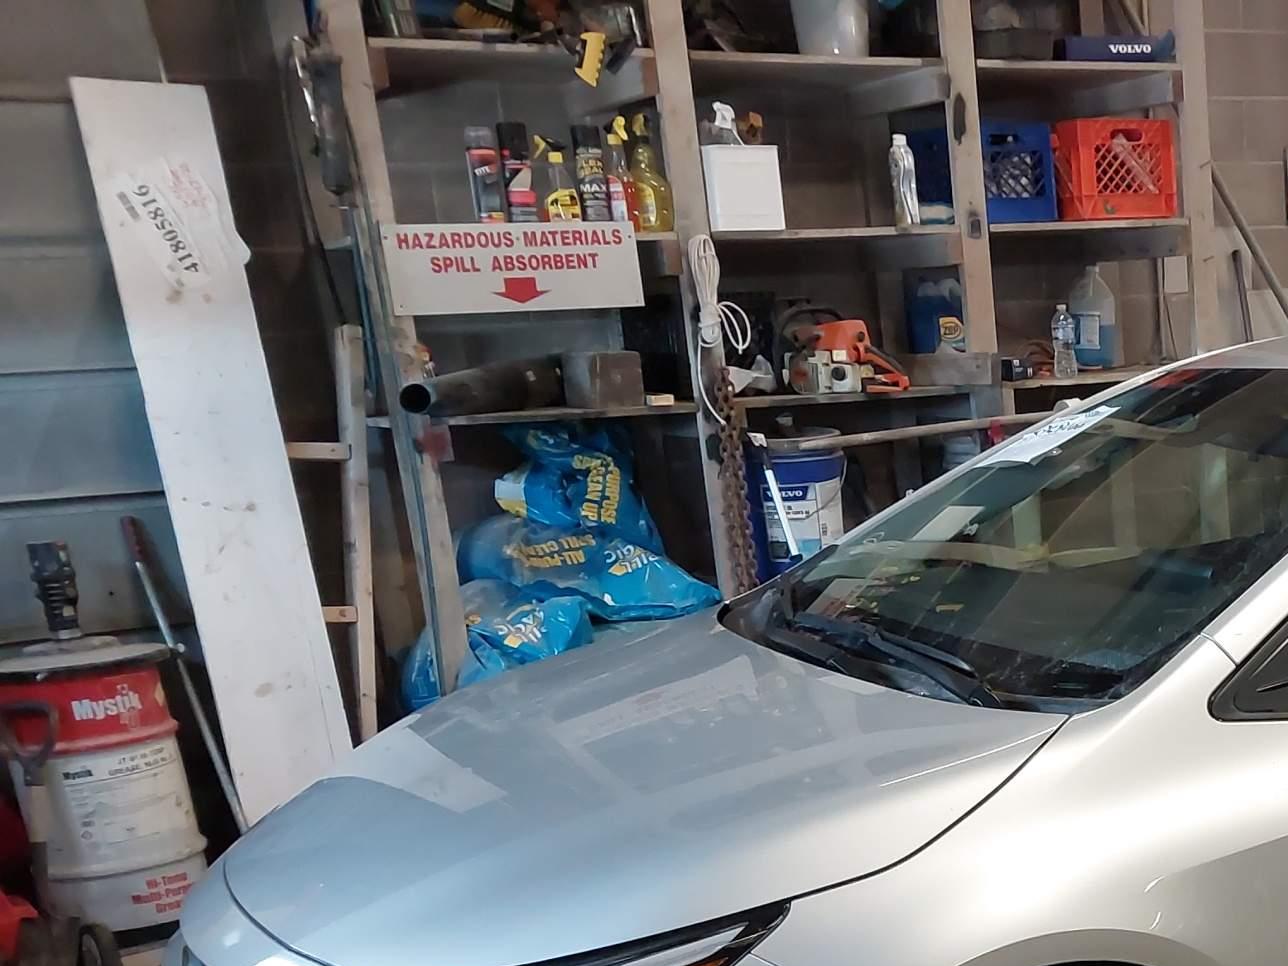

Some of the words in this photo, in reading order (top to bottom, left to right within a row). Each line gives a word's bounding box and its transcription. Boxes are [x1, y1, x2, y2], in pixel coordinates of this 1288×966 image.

[1108, 43, 1152, 54] VOLVO
[580, 183, 607, 193] MAX
[132, 184, 200, 273] 41805816
[396, 231, 515, 250] HAZARDOUS
[523, 228, 623, 247] MATERIALS
[430, 255, 481, 273] SPILL
[491, 252, 599, 272] ABSORBENT
[621, 552, 659, 573] PILL
[71, 690, 142, 721] Mystik
